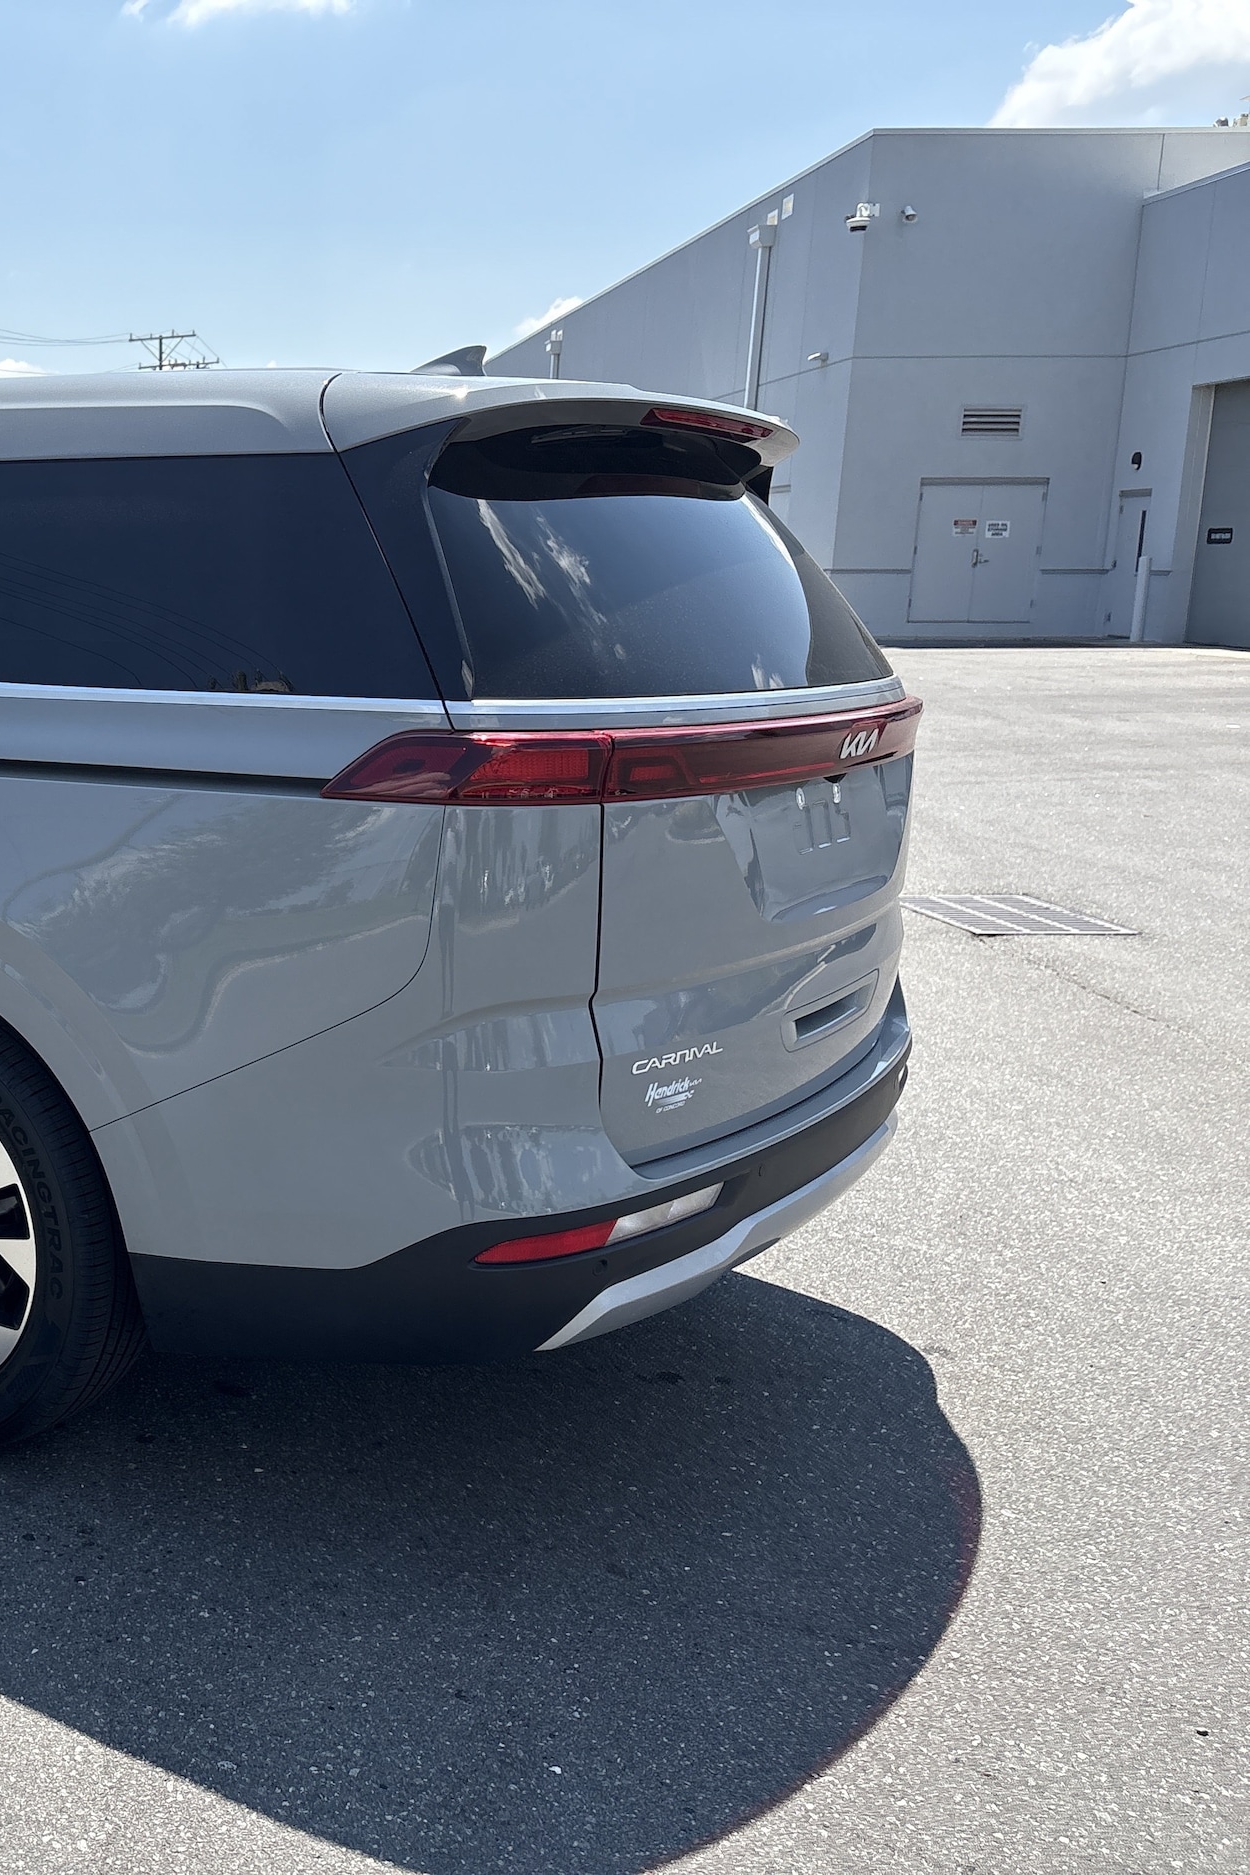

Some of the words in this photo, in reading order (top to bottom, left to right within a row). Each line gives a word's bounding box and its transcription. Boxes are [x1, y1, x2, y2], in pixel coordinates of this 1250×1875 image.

[840, 728, 879, 759] KIA
[631, 1041, 724, 1075] CARNIVAL
[644, 1076, 690, 1107] Hendrick
